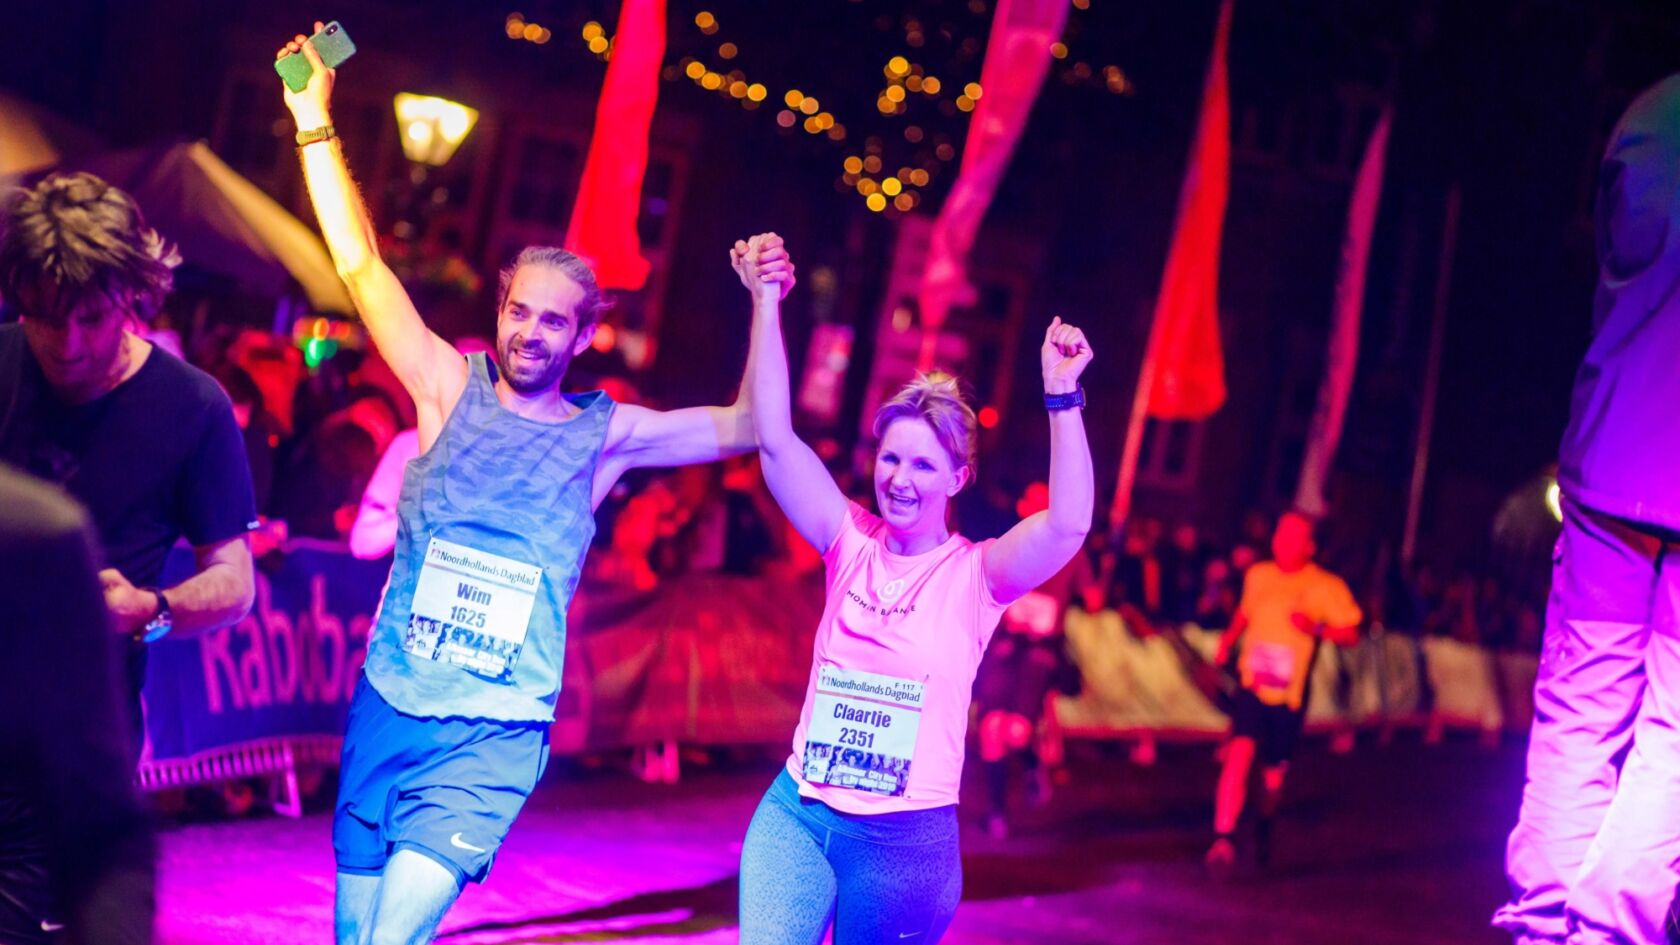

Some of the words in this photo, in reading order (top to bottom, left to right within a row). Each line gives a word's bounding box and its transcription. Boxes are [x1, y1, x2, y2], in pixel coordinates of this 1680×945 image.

[440, 551, 499, 575] Noordhollands
[500, 568, 536, 586] Dagblad
[457, 582, 492, 606] Wim
[450, 605, 487, 628] 1625
[200, 571, 371, 712] Raboba
[830, 676, 884, 695] Noordhollands
[884, 686, 921, 702] Dagblad
[902, 683, 916, 691] 117
[833, 702, 891, 728] Claartje
[838, 727, 875, 748] 2351
